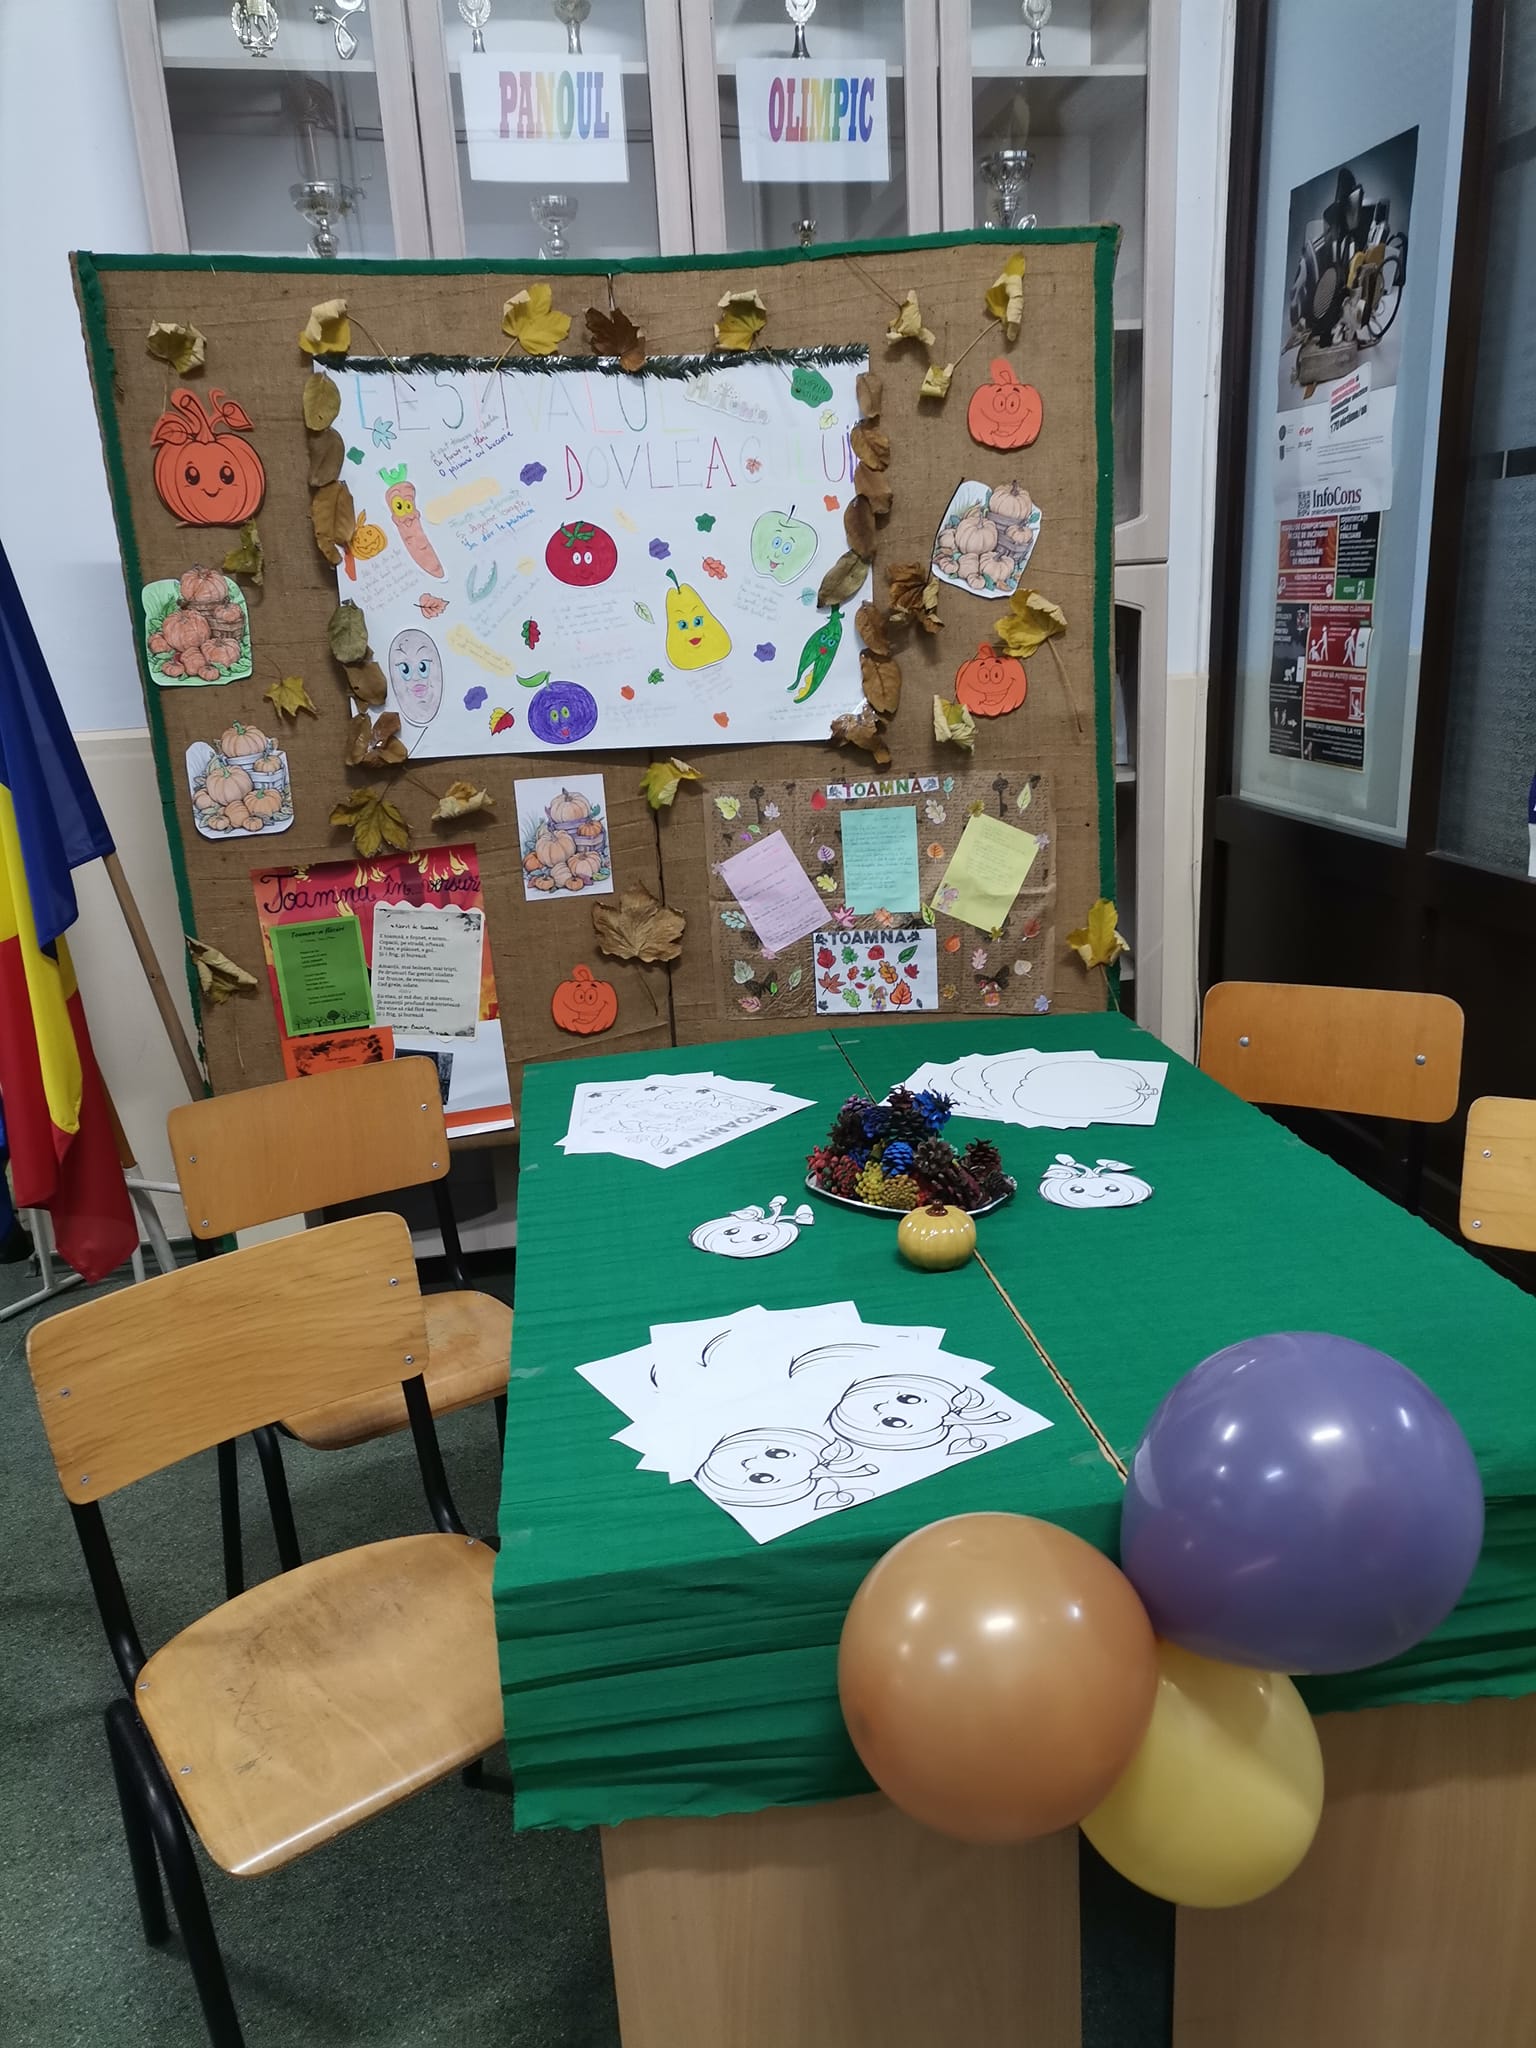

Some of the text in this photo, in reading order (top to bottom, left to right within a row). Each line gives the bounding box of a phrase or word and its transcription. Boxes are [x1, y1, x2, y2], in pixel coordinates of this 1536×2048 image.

[498, 70, 875, 143] PANOUL OLIMPIC
[1312, 486, 1362, 507] InfoCons
[842, 777, 923, 797] TOAMNA
[260, 868, 372, 914] Toamna
[424, 873, 481, 893] versuri
[827, 930, 907, 946] TOAMNA
[677, 1112, 768, 1149] TOAMNA
